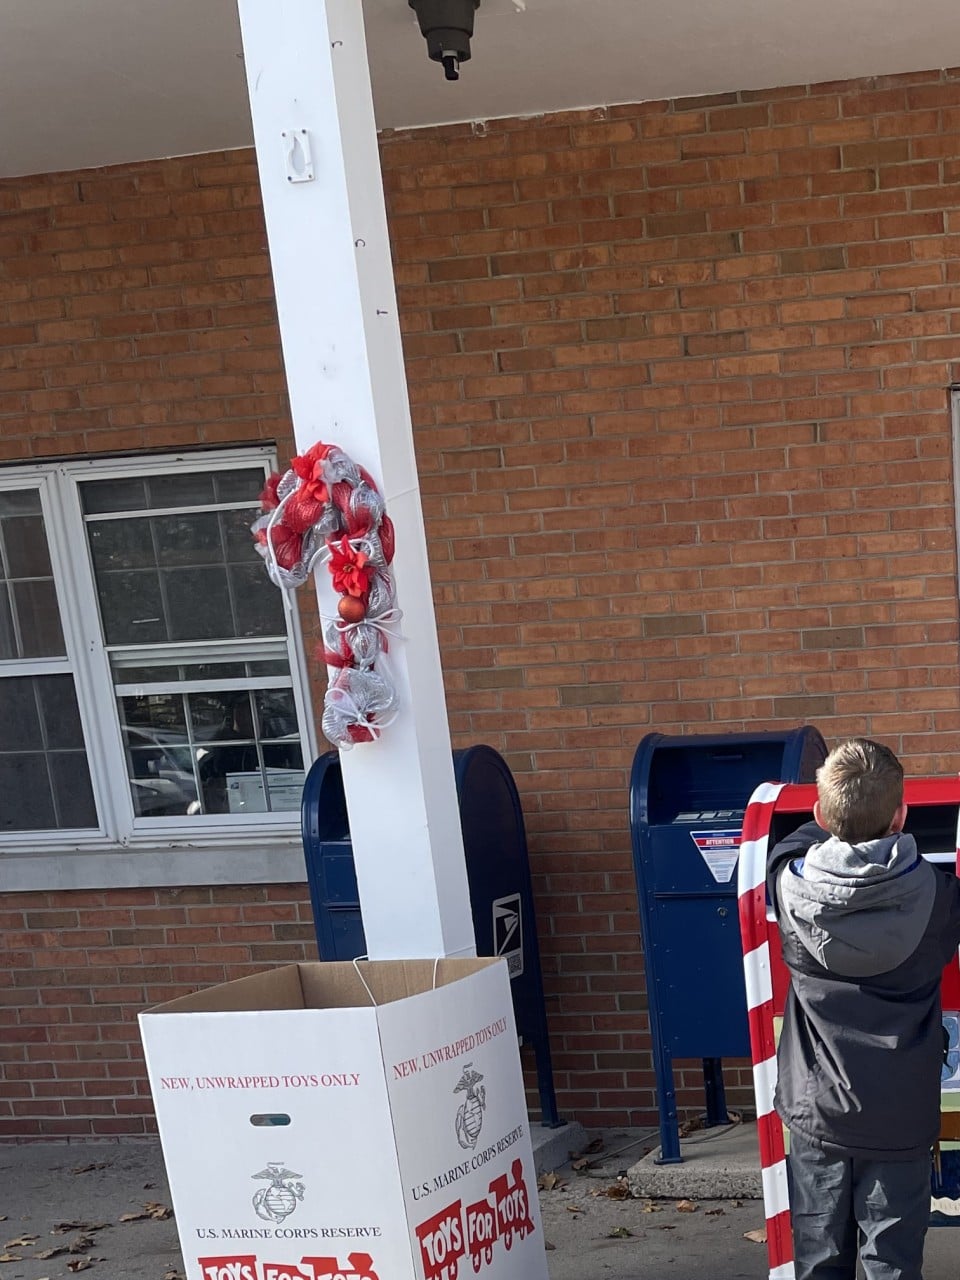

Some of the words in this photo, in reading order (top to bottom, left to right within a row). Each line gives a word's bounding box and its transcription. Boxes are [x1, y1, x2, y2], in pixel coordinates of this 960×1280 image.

[705, 838, 734, 846] ATTENTION
[422, 1035, 475, 1069] UNWRAPPED
[475, 1025, 492, 1046] TOYS
[491, 1016, 507, 1037] ONLY
[160, 1077, 194, 1090] NEW,
[196, 1076, 280, 1089] UNWRAPPED
[281, 1075, 319, 1088] TOYS
[321, 1073, 360, 1087] ONLY
[411, 1182, 432, 1201] U.S.
[433, 1160, 471, 1192] MARINE
[471, 1144, 497, 1170] CORPS
[496, 1124, 524, 1154] RESERVE
[196, 1228, 219, 1239] U.S.
[221, 1228, 273, 1239] MARINE
[274, 1227, 319, 1239] CORPS
[321, 1226, 382, 1238] RESERVE
[421, 1216, 462, 1267] TOYS
[468, 1211, 493, 1244] FOR
[498, 1188, 526, 1225] TOTS
